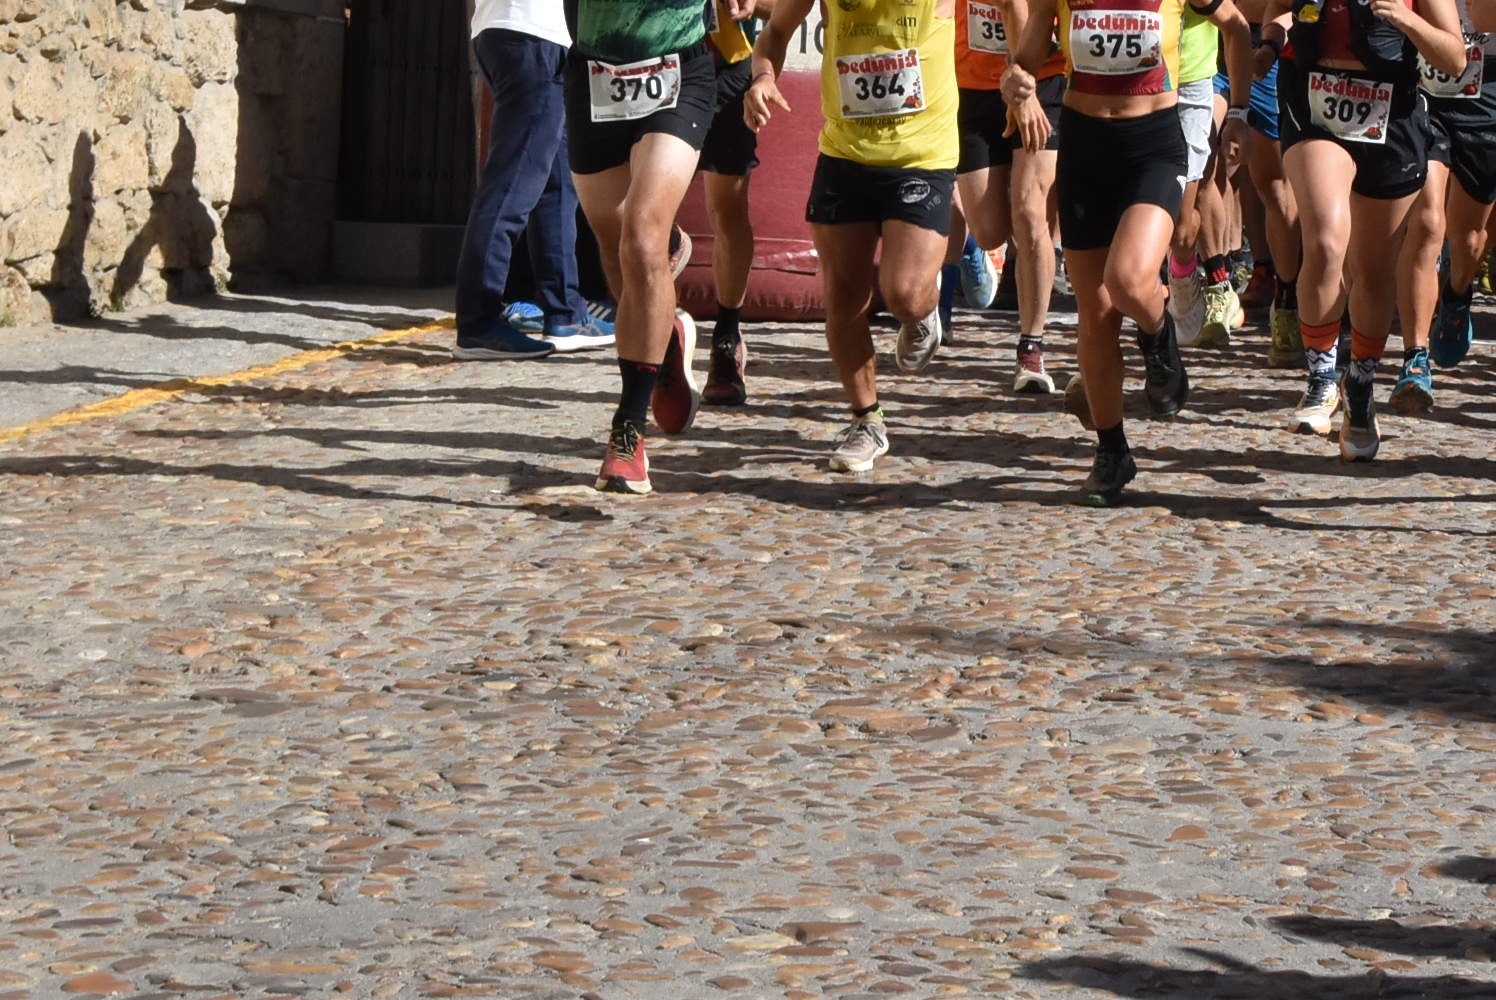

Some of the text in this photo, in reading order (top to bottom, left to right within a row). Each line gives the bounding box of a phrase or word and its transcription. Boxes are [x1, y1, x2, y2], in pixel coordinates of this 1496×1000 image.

[1072, 14, 1160, 31] bedunia
[1088, 33, 1142, 58] 375
[837, 53, 918, 76] bedunia
[610, 75, 662, 103] 370
[855, 72, 905, 101] 364
[1311, 75, 1390, 101] bedunia
[1323, 96, 1371, 125] 309
